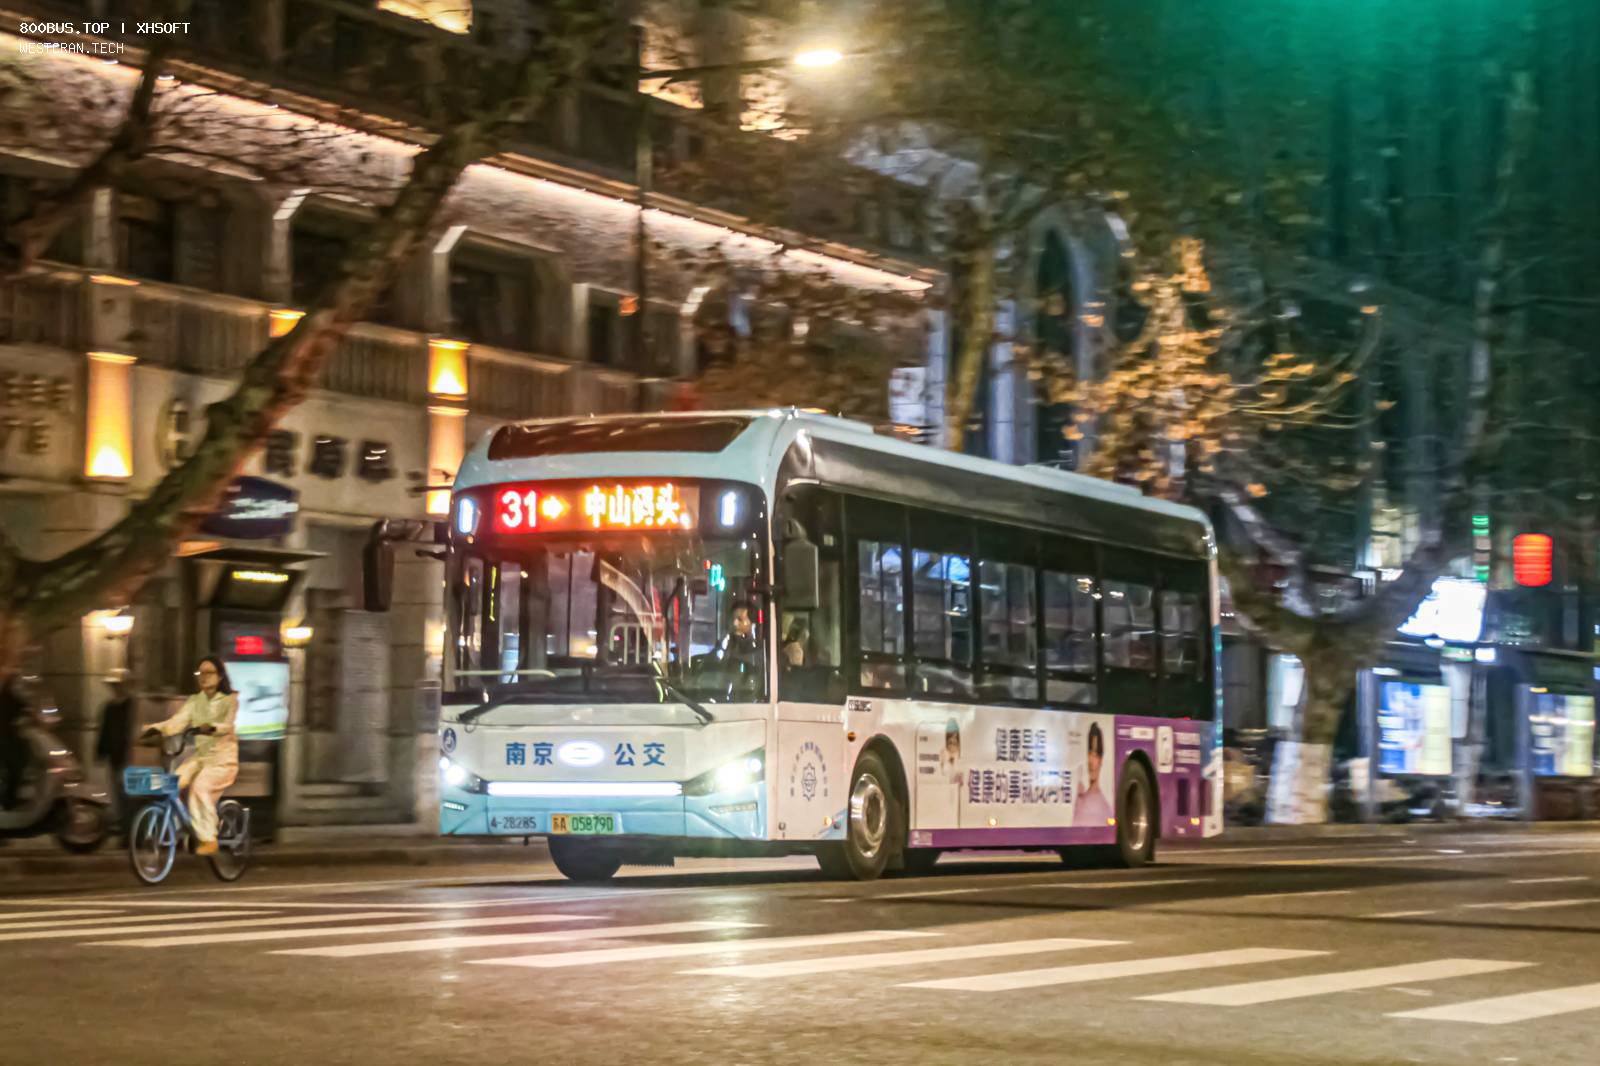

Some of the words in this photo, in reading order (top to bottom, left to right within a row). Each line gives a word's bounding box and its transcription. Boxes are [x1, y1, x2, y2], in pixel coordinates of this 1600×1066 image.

[501, 490, 538, 528] 31
[505, 742, 554, 766] 南京
[614, 742, 666, 767] 公交
